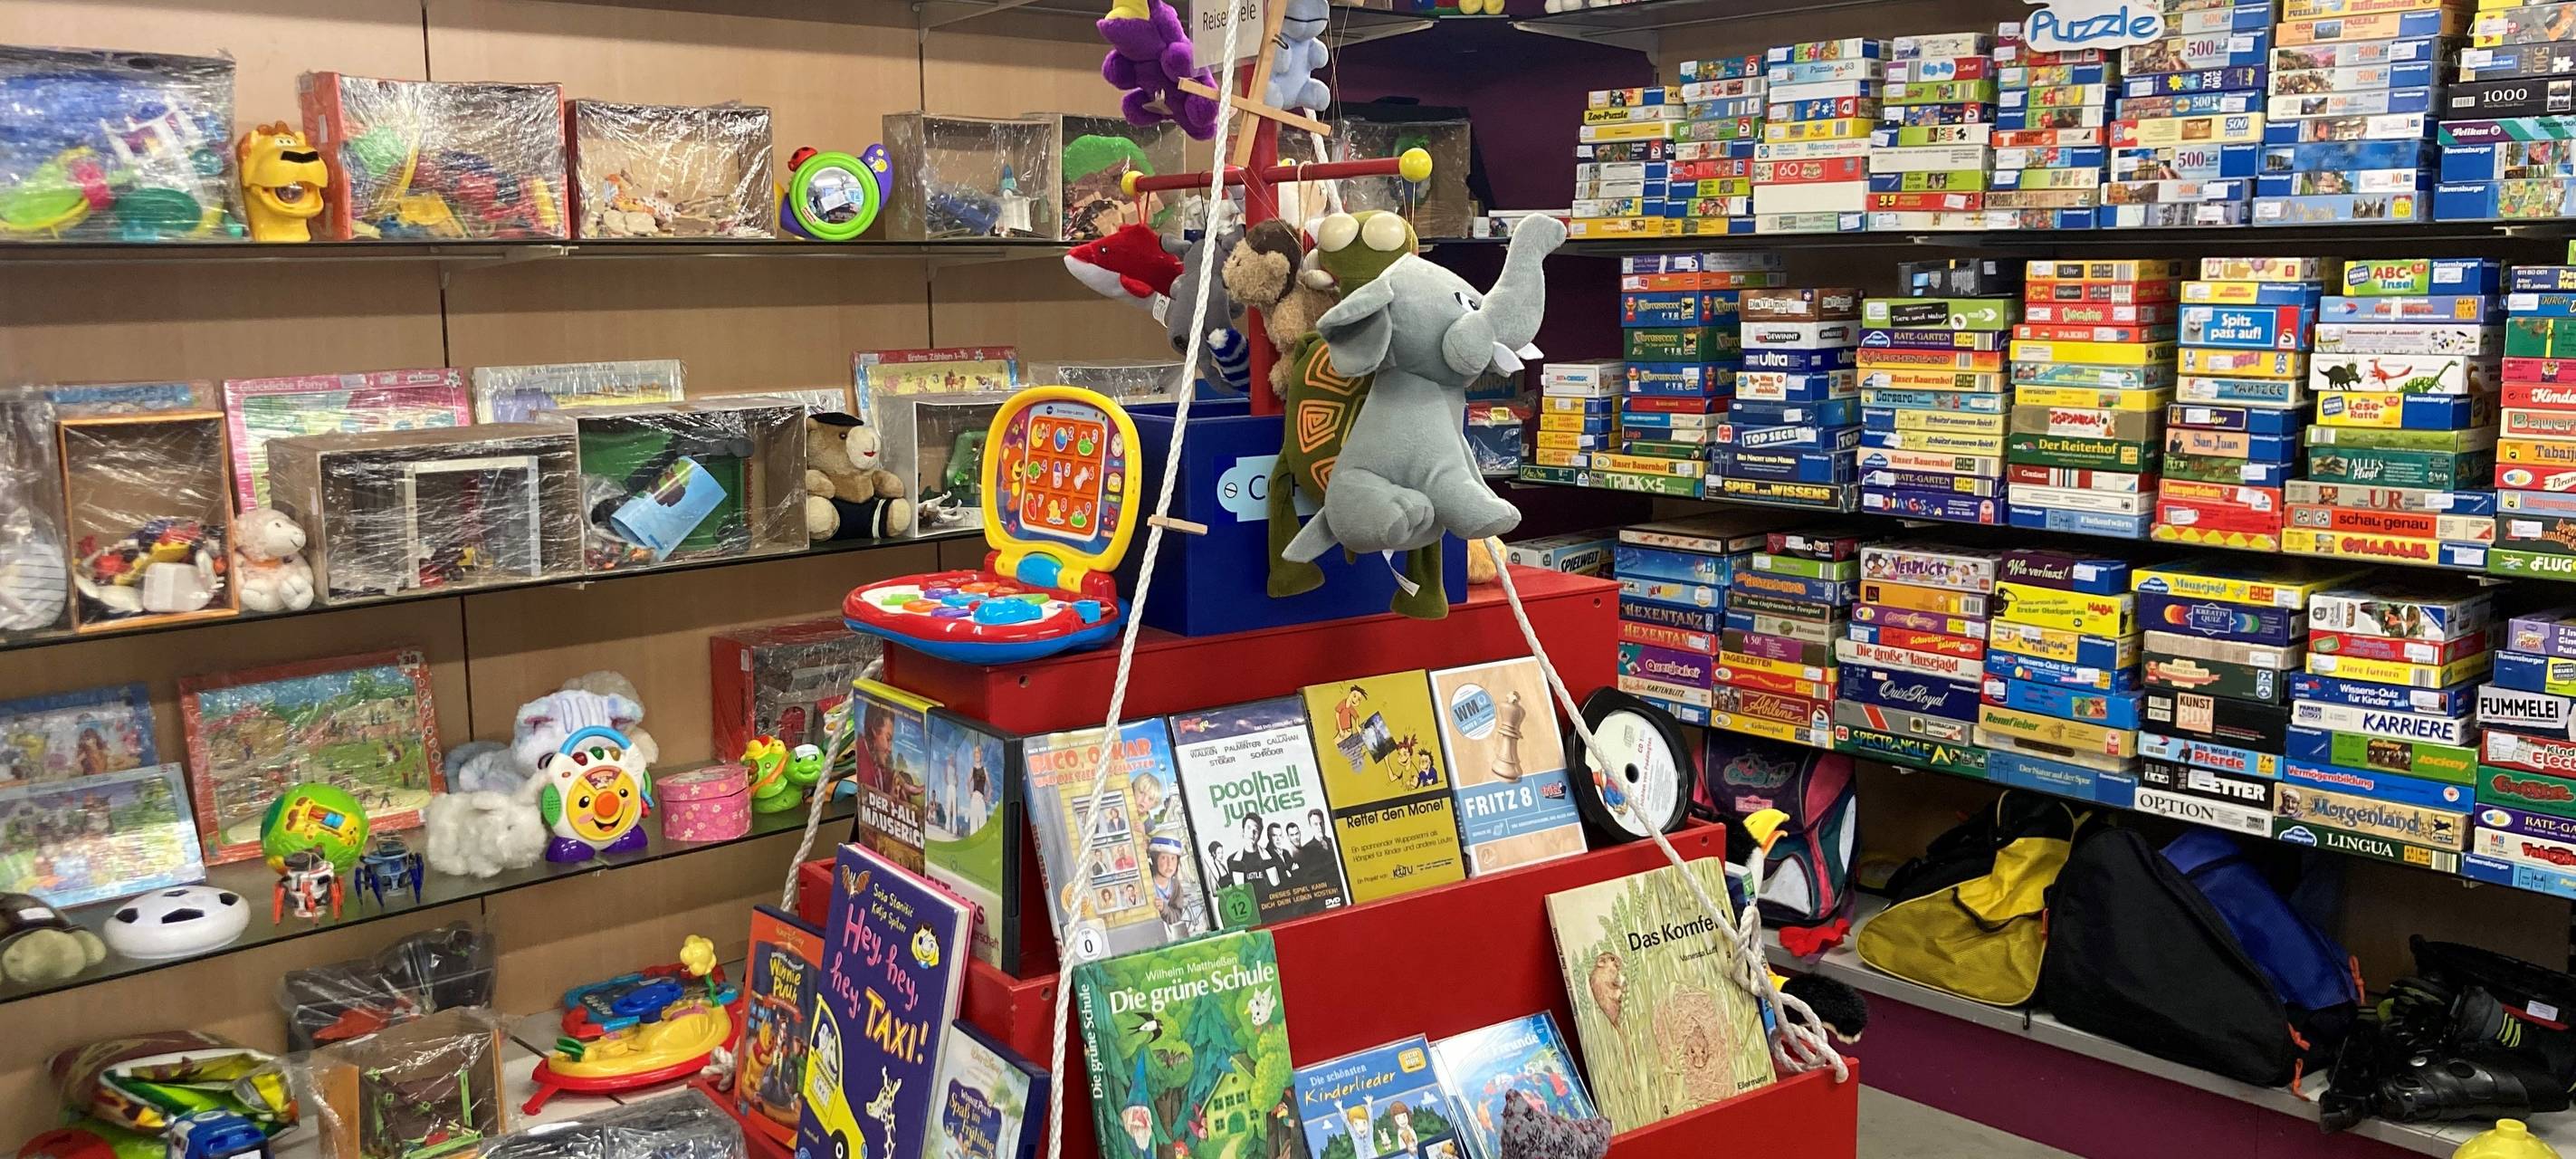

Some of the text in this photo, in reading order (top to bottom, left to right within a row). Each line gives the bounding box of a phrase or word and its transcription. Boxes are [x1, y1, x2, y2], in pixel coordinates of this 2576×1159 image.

[2031, 5, 2158, 43] Puzzle
[2187, 40, 2214, 57] 500
[2358, 45, 2379, 59] 500
[2192, 96, 2211, 109] 500
[2483, 89, 2528, 102] 1000
[1588, 110, 1628, 121] Zoo-Puzzle
[2226, 117, 2248, 129] 500
[2451, 126, 2489, 137] Pelikan
[2444, 146, 2492, 156] Ravensburger
[2178, 150, 2204, 168] 500
[1779, 163, 1798, 177] 60
[2438, 185, 2485, 194] Ravensburger
[1878, 194, 1896, 206] 99
[2063, 265, 2079, 276] Uhr
[2372, 265, 2410, 280] ABC-
[2432, 261, 2478, 269] Ravensburger
[2380, 279, 2415, 291] Insel
[2541, 295, 2569, 306] DURCH
[1892, 314, 1910, 322] Tiere
[1912, 313, 1925, 321] und
[2220, 312, 2252, 328] Spitz
[1765, 332, 1798, 341] GEWINNT
[1894, 331, 1951, 342] RATE-GARTEN
[2210, 324, 2261, 341] pass auf!
[908, 351, 953, 362] Erstes Zählen
[1759, 348, 1789, 367] ultra
[1861, 350, 1951, 364] MÄRCHENLAND
[297, 379, 329, 390] Ponys
[1891, 374, 1953, 385] Unser Bauernhof
[1875, 388, 1913, 405] Corsaro
[2406, 395, 2451, 405] Ravensburger
[2347, 400, 2384, 412] Lese-
[2349, 410, 2379, 421] Ratte
[1744, 432, 1768, 446] TOP
[1977, 438, 1998, 449] Teich!
[2192, 434, 2238, 451] San Juan
[2038, 440, 2118, 455] Der Reiterhof
[1611, 458, 1668, 473] Unser Bauernhof
[1891, 455, 1953, 468] Unser Bauernhof
[2350, 458, 2384, 471] ALLES
[1041, 460, 1095, 480] 4 5 6
[2020, 469, 2047, 479] Contact
[2352, 467, 2380, 481] Fliegt
[1723, 479, 1758, 494] SPIEL
[1770, 484, 1831, 501] WISSENS
[1038, 495, 1092, 515] 7 8 9
[2369, 489, 2404, 509] UR
[2338, 512, 2428, 532] schau genau
[1560, 550, 1600, 572] SPIELWELT
[2530, 555, 2572, 572] FLUG
[2007, 559, 2069, 580] Wie verhext!
[1625, 602, 1703, 625] HEXENTANZ
[2017, 606, 2086, 617] Erster Obstgarten
[2087, 601, 2114, 616] HABA
[2195, 607, 2228, 618] KREATIV
[2201, 615, 2221, 624] QUIZ
[1722, 652, 1772, 668] TAGESZEITEN
[1856, 644, 1872, 657] Die
[1874, 647, 1903, 663] große
[2497, 652, 2545, 666] Ravensburger
[2341, 663, 2361, 674] Tiere
[1646, 684, 1685, 698] KARTENBLITZ
[1908, 684, 1949, 711] Royal
[2339, 683, 2399, 700] Wissens-Quiz
[2179, 694, 2211, 710] KUNST
[2480, 696, 2559, 719] FUMMELEI
[1454, 698, 1481, 723] WM
[1985, 712, 2040, 732] Rennfieber
[2362, 713, 2455, 741] KARRIERE
[1267, 734, 1299, 745] CALLAHAN
[1189, 748, 1218, 759] WALKEN
[2194, 744, 2246, 760] Die Welt der
[1209, 756, 1236, 767] STEIGER
[2194, 752, 2246, 770] Pferde
[2286, 764, 2373, 790] Vermögensbildung
[1208, 764, 1301, 809] poolhall
[868, 790, 889, 813] DER
[1222, 790, 1306, 827] junkies
[1464, 786, 1533, 819] FRITZ 8
[2139, 793, 2216, 820] OPTION
[1346, 798, 1445, 829] Rettet den Monet
[2311, 794, 2421, 835] Morgenland
[2325, 832, 2394, 858] LINGUA
[2490, 834, 2504, 847] MB
[2466, 855, 2510, 870] Ravensburger
[1312, 882, 1328, 892] KANN
[1231, 901, 1247, 916] 12
[1325, 896, 1341, 906] DVD
[1084, 939, 1093, 953] 0
[1627, 930, 1660, 953] Das
[843, 903, 920, 1012] Hey, hey,
[1679, 950, 1706, 963] Vanessa
[768, 960, 802, 986] Winnie
[1145, 954, 1238, 983] Wilhelm Matthießen
[772, 977, 798, 1004] Puuh
[829, 951, 862, 1020] hey,
[1109, 961, 1274, 1015] Die grüne Schule
[864, 986, 930, 1066] TAXI!
[1079, 983, 1104, 1099] Die grüne Schule
[1309, 1063, 1368, 1087] Die schönsten
[1737, 1075, 1768, 1090] Ellermann
[1304, 1071, 1397, 1106] Kinderlieder
[950, 1092, 981, 1121] Spaß im
